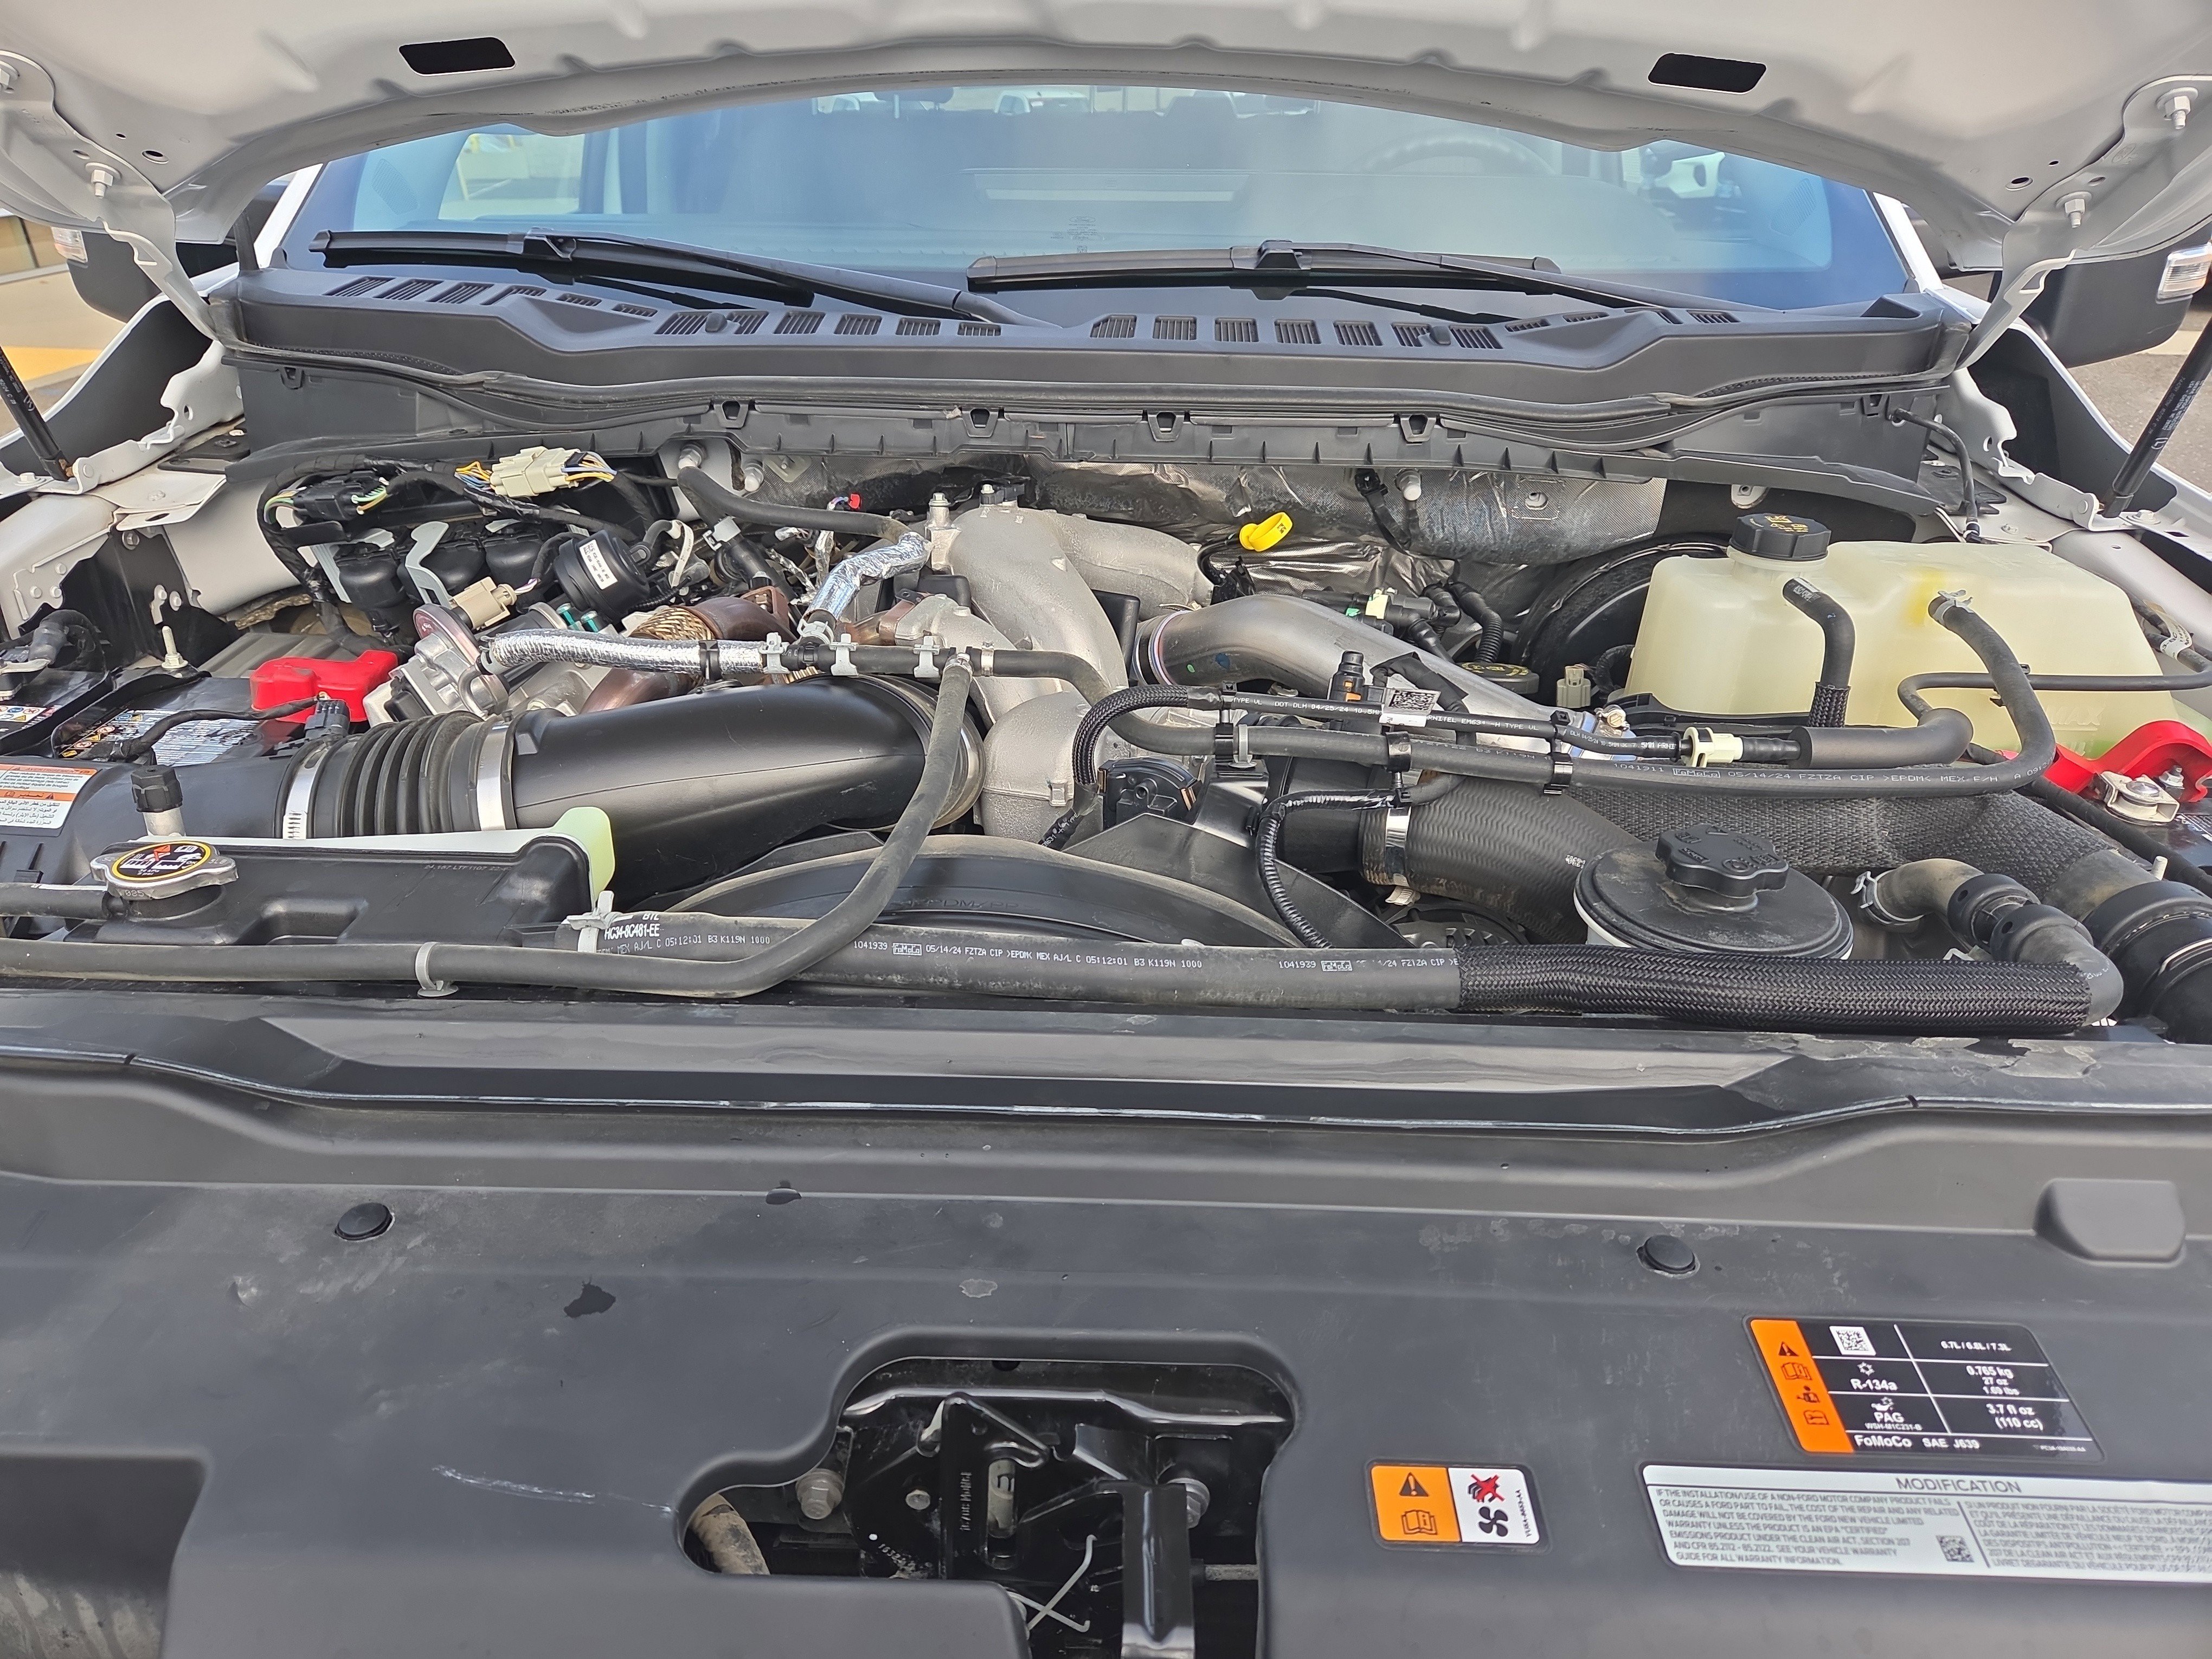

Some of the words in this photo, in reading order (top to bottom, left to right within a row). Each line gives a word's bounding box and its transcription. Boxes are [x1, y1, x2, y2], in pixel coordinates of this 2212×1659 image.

[1311, 704, 1349, 712] 04/25/24
[1426, 715, 1457, 723] RNITEL
[1613, 763, 1664, 773] 1041911
[1673, 768, 1721, 779] FoMoCo
[1728, 771, 1791, 780] 05/14/24
[604, 923, 660, 941] HC34-8C481-EE
[657, 938, 661, 948] C
[665, 934, 702, 947] 05:12:01
[708, 935, 718, 943] B3
[721, 935, 745, 944] K119N
[751, 935, 770, 944] 1000
[854, 941, 888, 950] 1041939
[893, 943, 922, 956] FoMoCo
[925, 944, 962, 954] 05/14/24
[964, 947, 987, 956] FZTZA
[989, 949, 1003, 957] CIP
[1037, 951, 1051, 961] MEX
[1076, 954, 1082, 963] C
[1085, 955, 1128, 966] 05:12:01
[1134, 957, 1146, 967] B3
[1148, 959, 1176, 968] K119N
[1181, 960, 1203, 968] 1000
[1850, 1378, 1898, 1391] R-134a
[1986, 1404, 2004, 1414] 3.7
[2018, 1407, 2035, 1416] oz
[1874, 1412, 1904, 1423] PAG
[1995, 1417, 2021, 1429] (110
[2023, 1418, 2043, 1431] cc)
[1854, 1435, 1913, 1448] FoMoCo
[1922, 1438, 1949, 1448] SAE
[1953, 1439, 1980, 1449] J639
[1895, 1477, 2022, 1493] MODIFICATION
